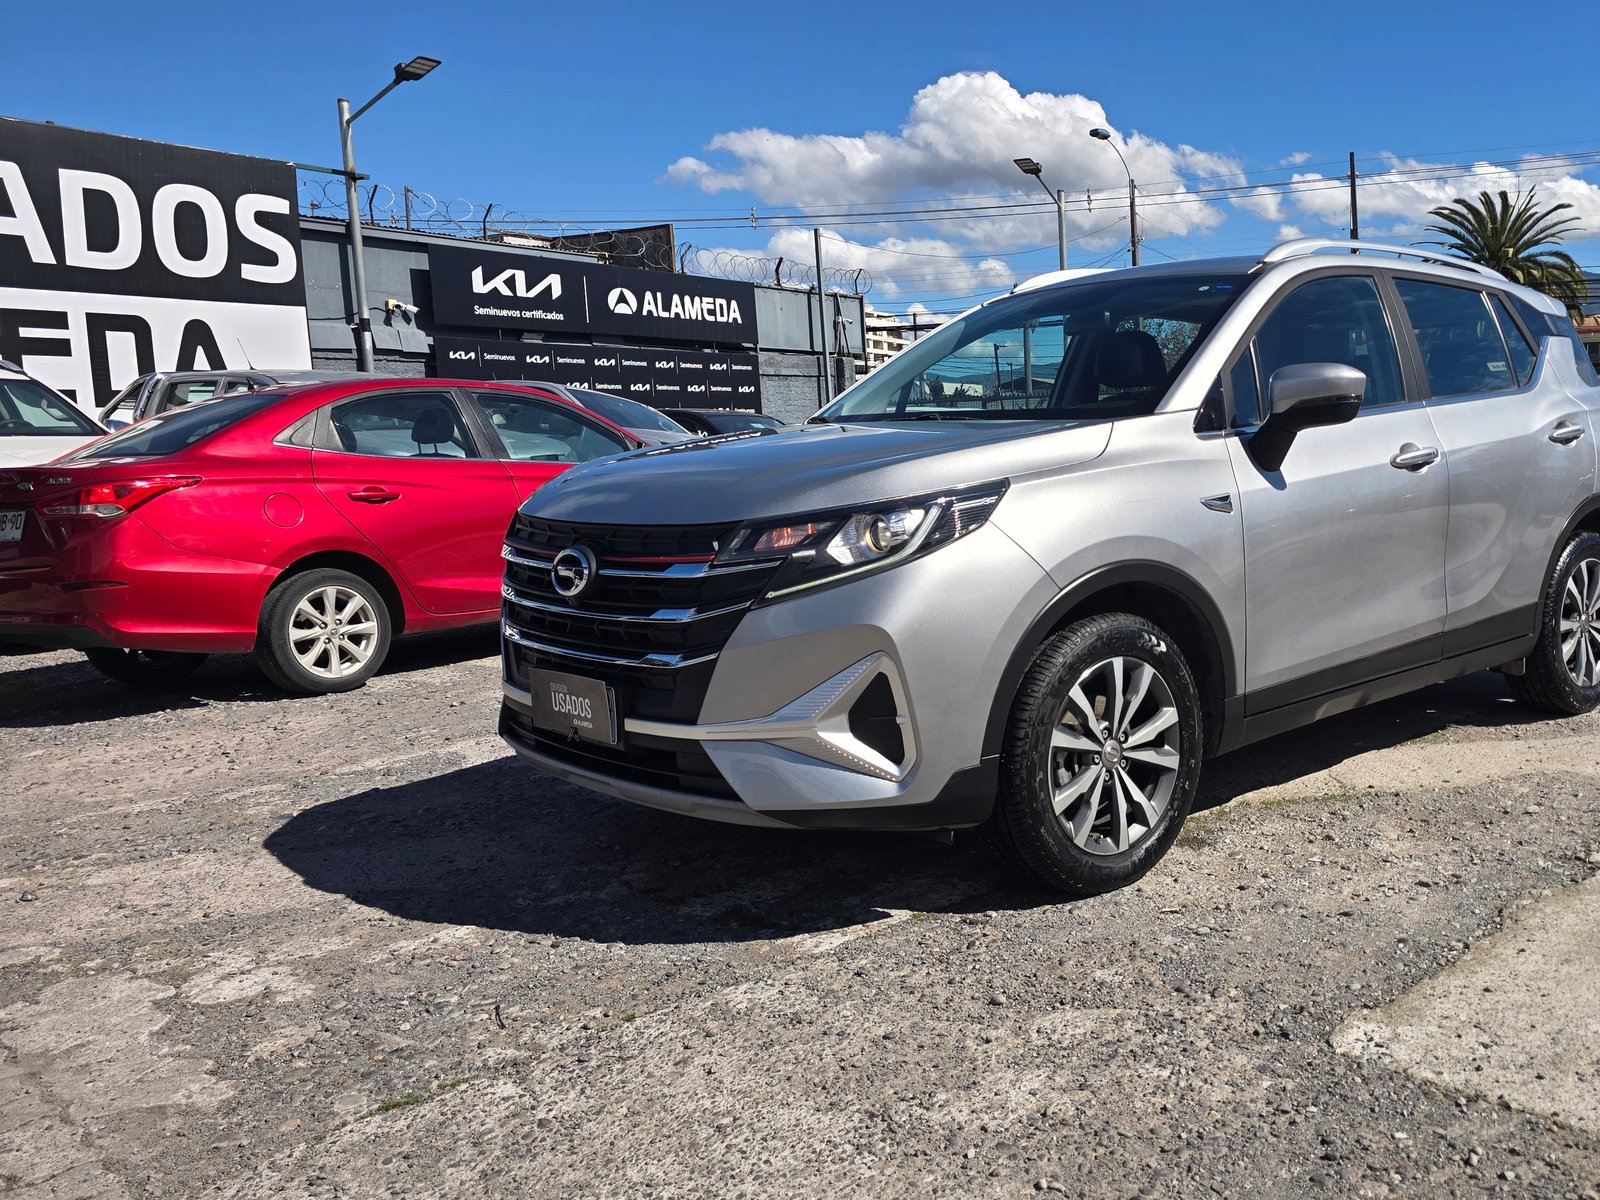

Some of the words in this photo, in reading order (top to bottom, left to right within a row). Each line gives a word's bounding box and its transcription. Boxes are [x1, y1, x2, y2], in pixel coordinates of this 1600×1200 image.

[472, 266, 562, 300] KIA
[474, 305, 520, 317] Seminuevos
[522, 310, 564, 320] certificados
[642, 291, 742, 324] ALAMEDA
[449, 351, 475, 360] KIA
[526, 355, 549, 363] KIA
[594, 358, 615, 366] KIA
[551, 692, 592, 719] USADOS
